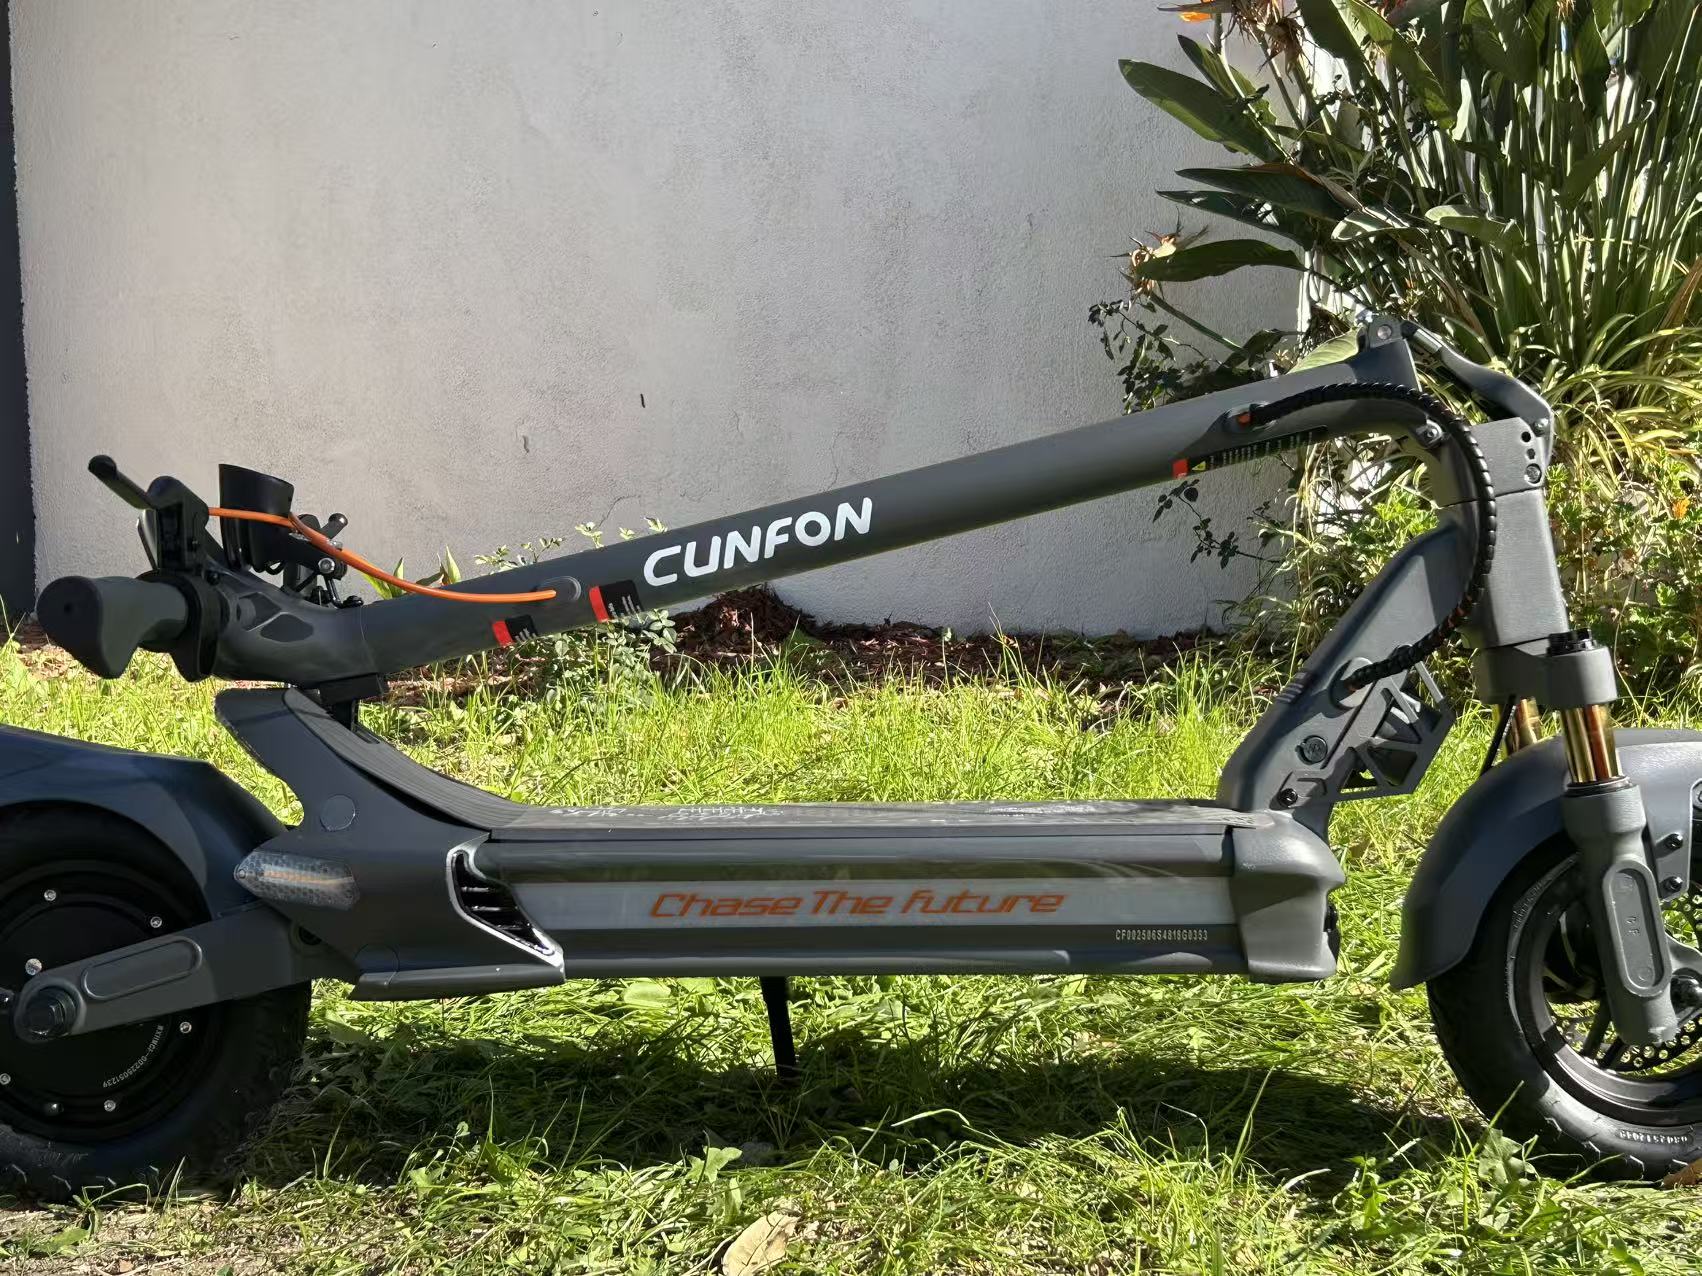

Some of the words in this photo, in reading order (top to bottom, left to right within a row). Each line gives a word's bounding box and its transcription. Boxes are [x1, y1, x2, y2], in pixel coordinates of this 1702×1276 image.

[643, 497, 873, 587] CUNFON
[650, 892, 803, 918] Chase
[811, 890, 893, 914] The
